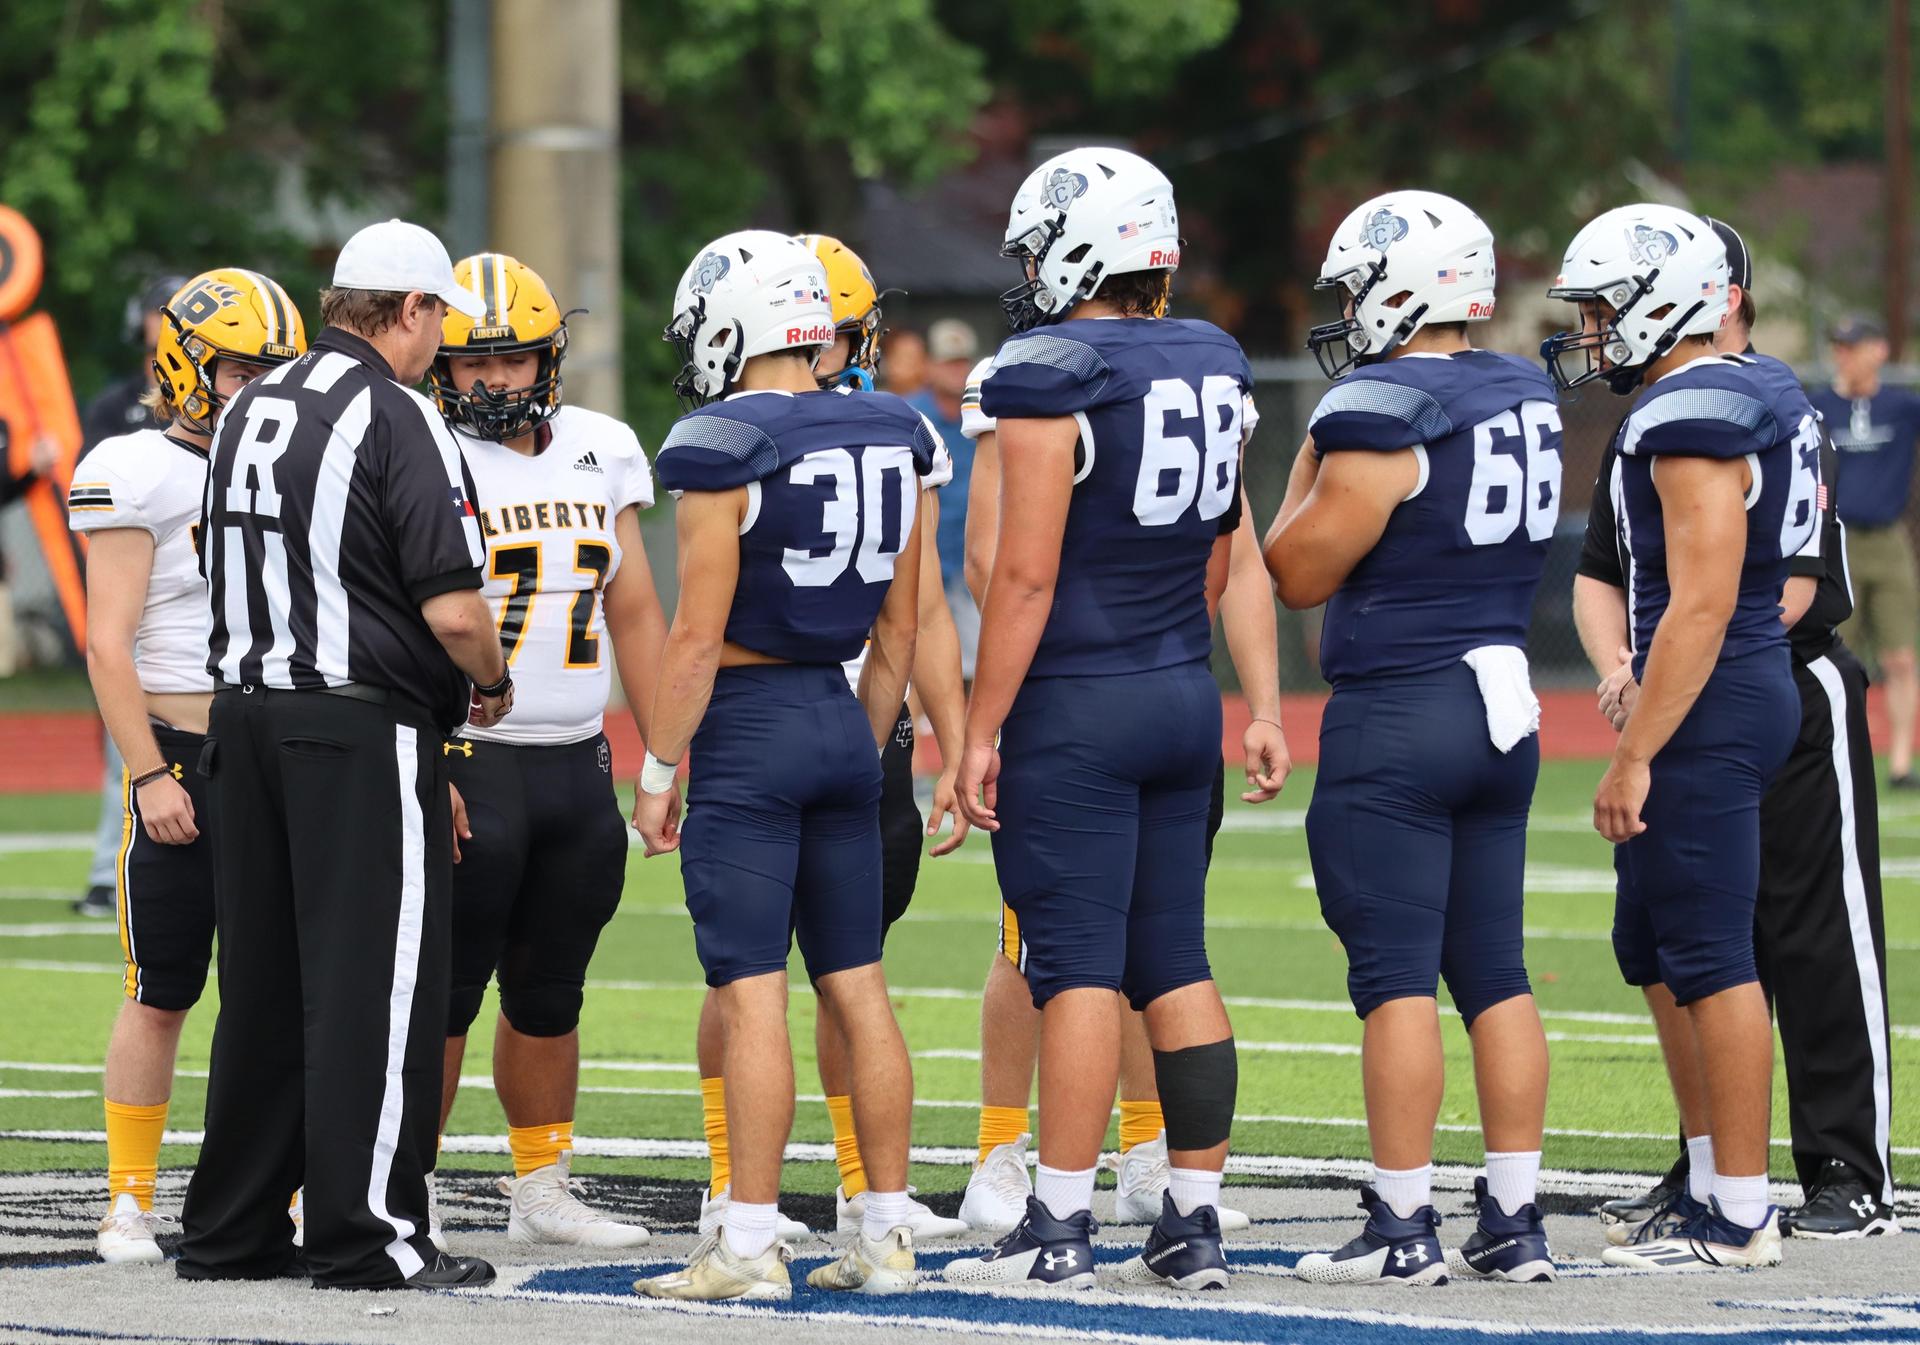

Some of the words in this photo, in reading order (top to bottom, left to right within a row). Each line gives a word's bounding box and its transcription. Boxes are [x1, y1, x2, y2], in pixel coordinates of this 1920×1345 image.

[1055, 186, 1068, 203] C
[1374, 228, 1387, 244] C
[700, 269, 711, 287] C
[267, 344, 297, 358] LIBERTY
[472, 327, 509, 339] LIBERTY
[226, 396, 298, 518] R
[573, 463, 604, 474] adidas
[1132, 375, 1244, 526] 68
[1463, 400, 1564, 545] 66
[1780, 415, 1821, 558] 6
[480, 502, 606, 538] LIBERTY
[782, 446, 916, 586] 30
[488, 539, 613, 669] 72
